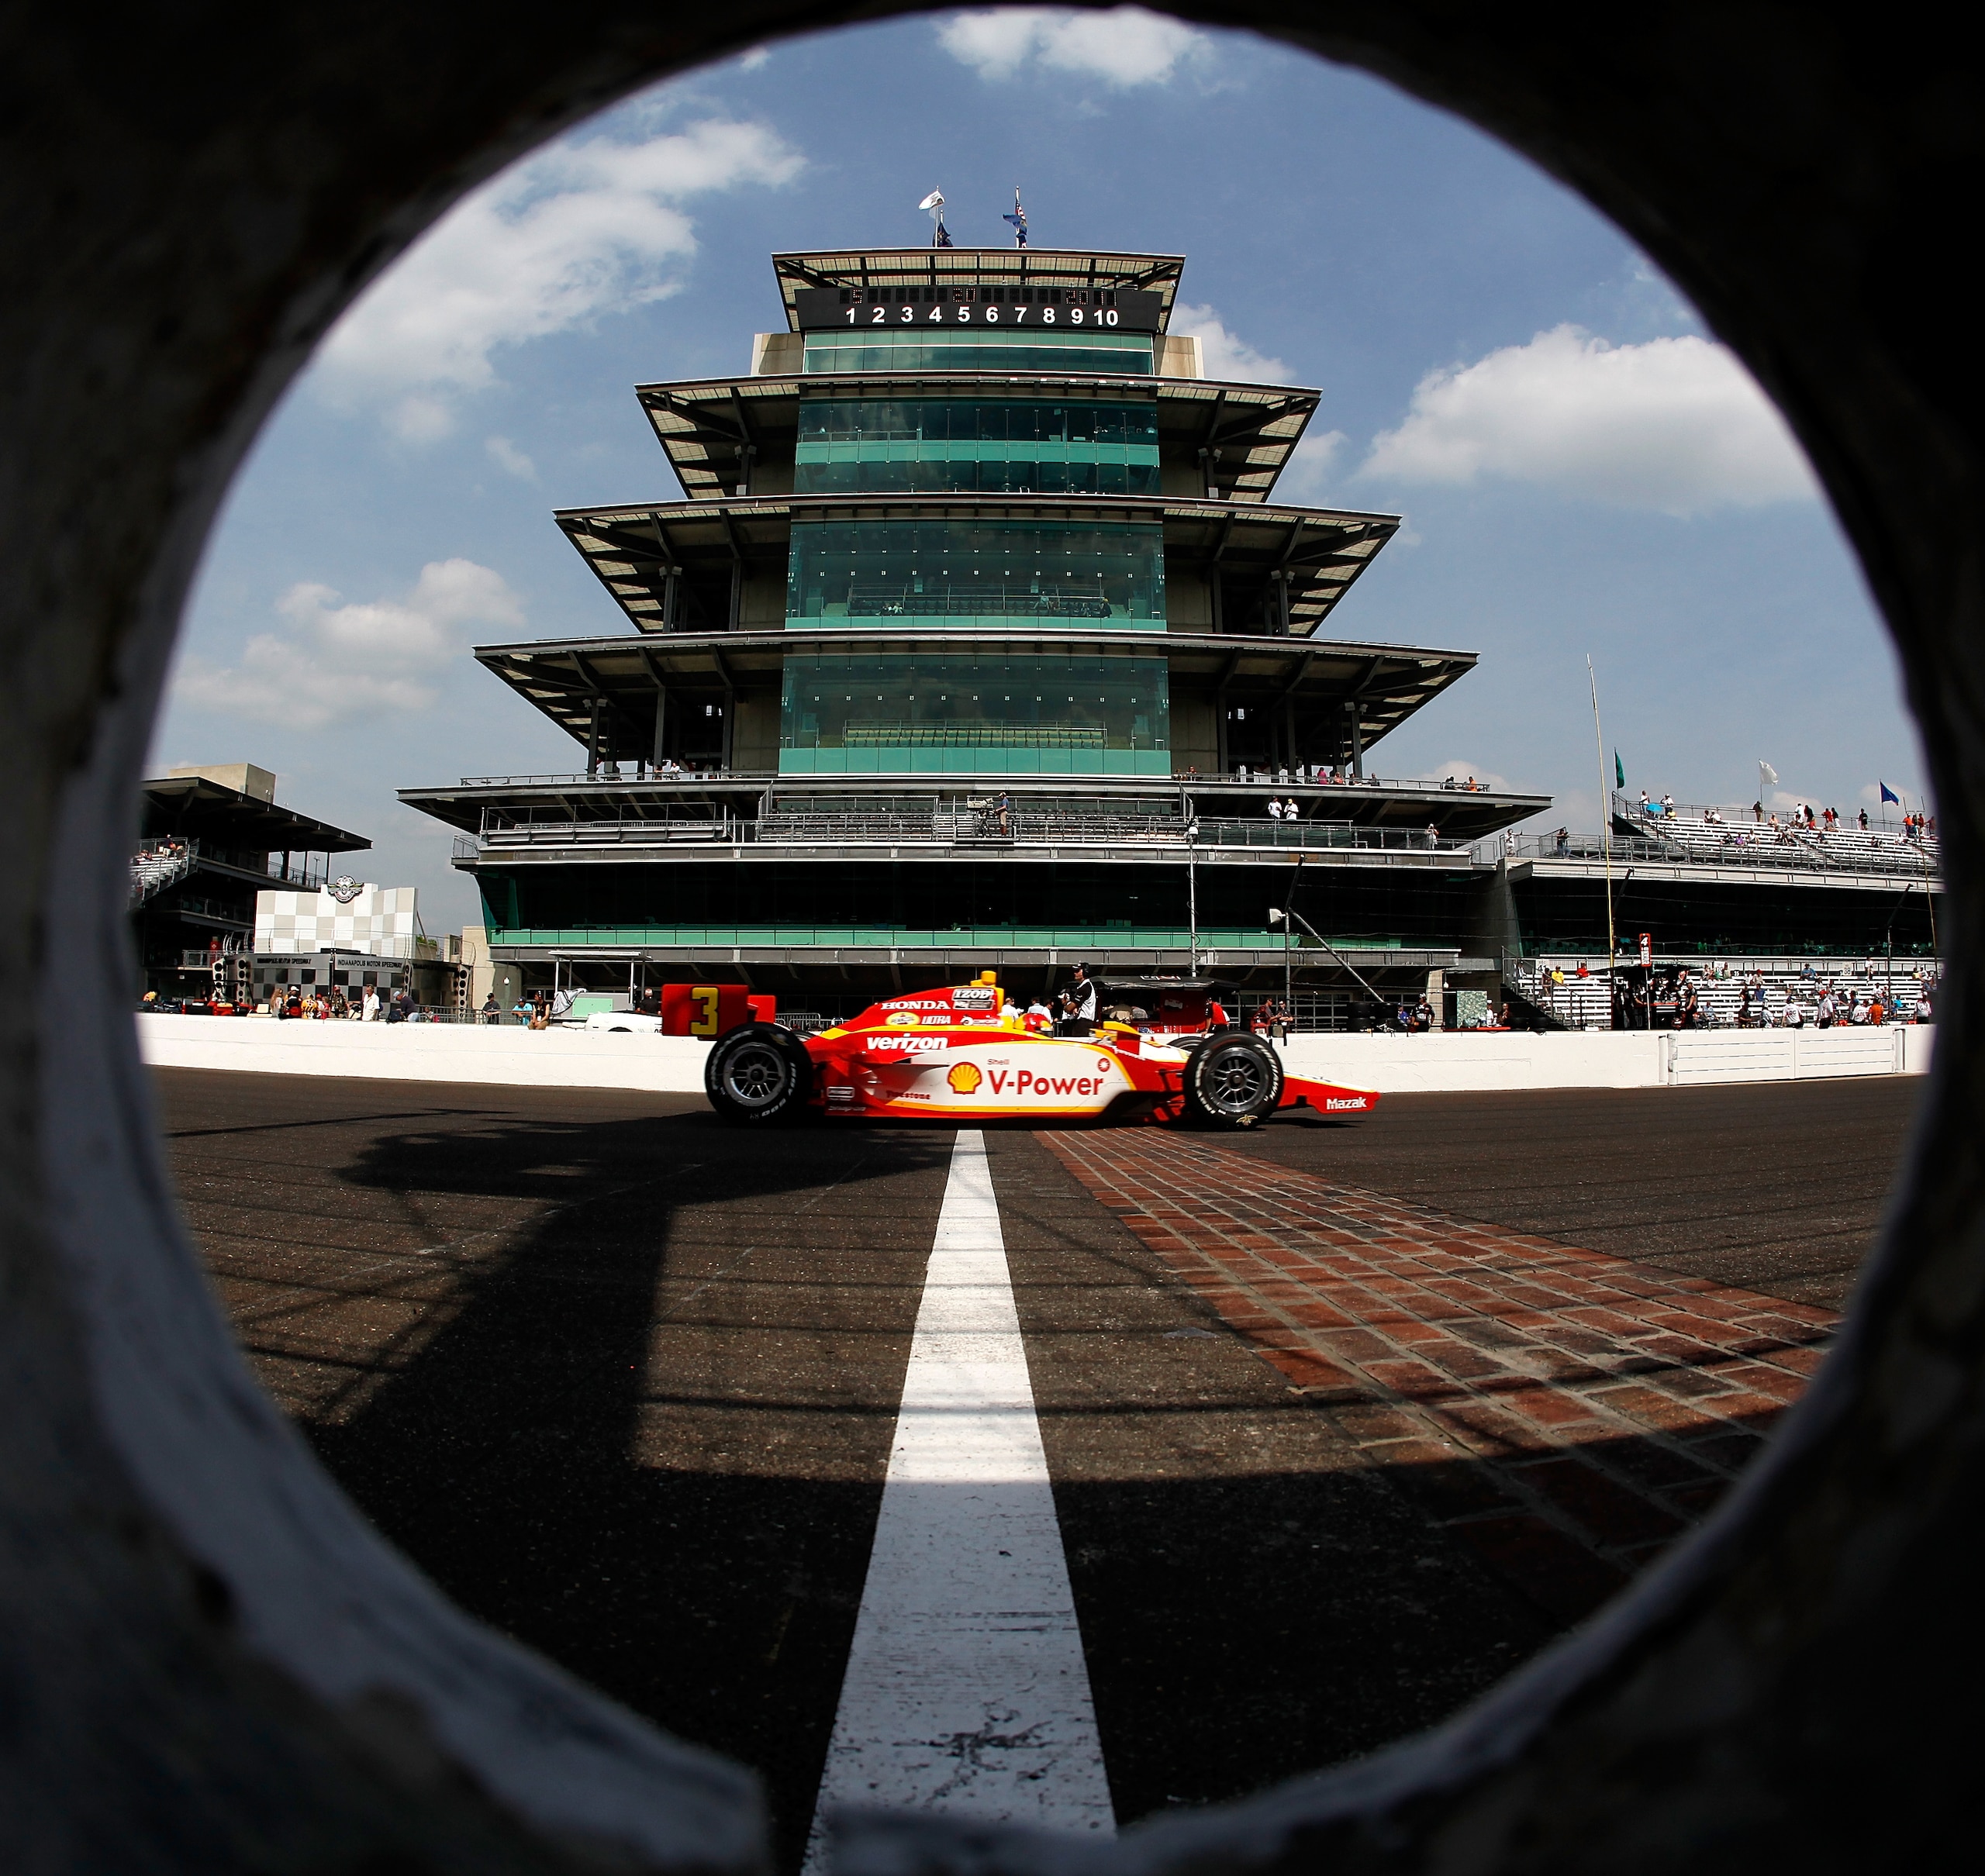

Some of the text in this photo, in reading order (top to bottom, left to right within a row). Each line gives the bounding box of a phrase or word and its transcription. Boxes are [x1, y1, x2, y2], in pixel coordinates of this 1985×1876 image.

[846, 306, 1118, 326] 1 2 3 4 5 6 7 8 9 10
[955, 990, 992, 998] IZOD
[691, 987, 718, 1035] 3
[881, 1001, 951, 1009] HONDA
[921, 1016, 951, 1024] ULTRA
[867, 1033, 948, 1054] verizon
[987, 1071, 1104, 1095] V-Power
[1326, 1096, 1367, 1110] Mazak
